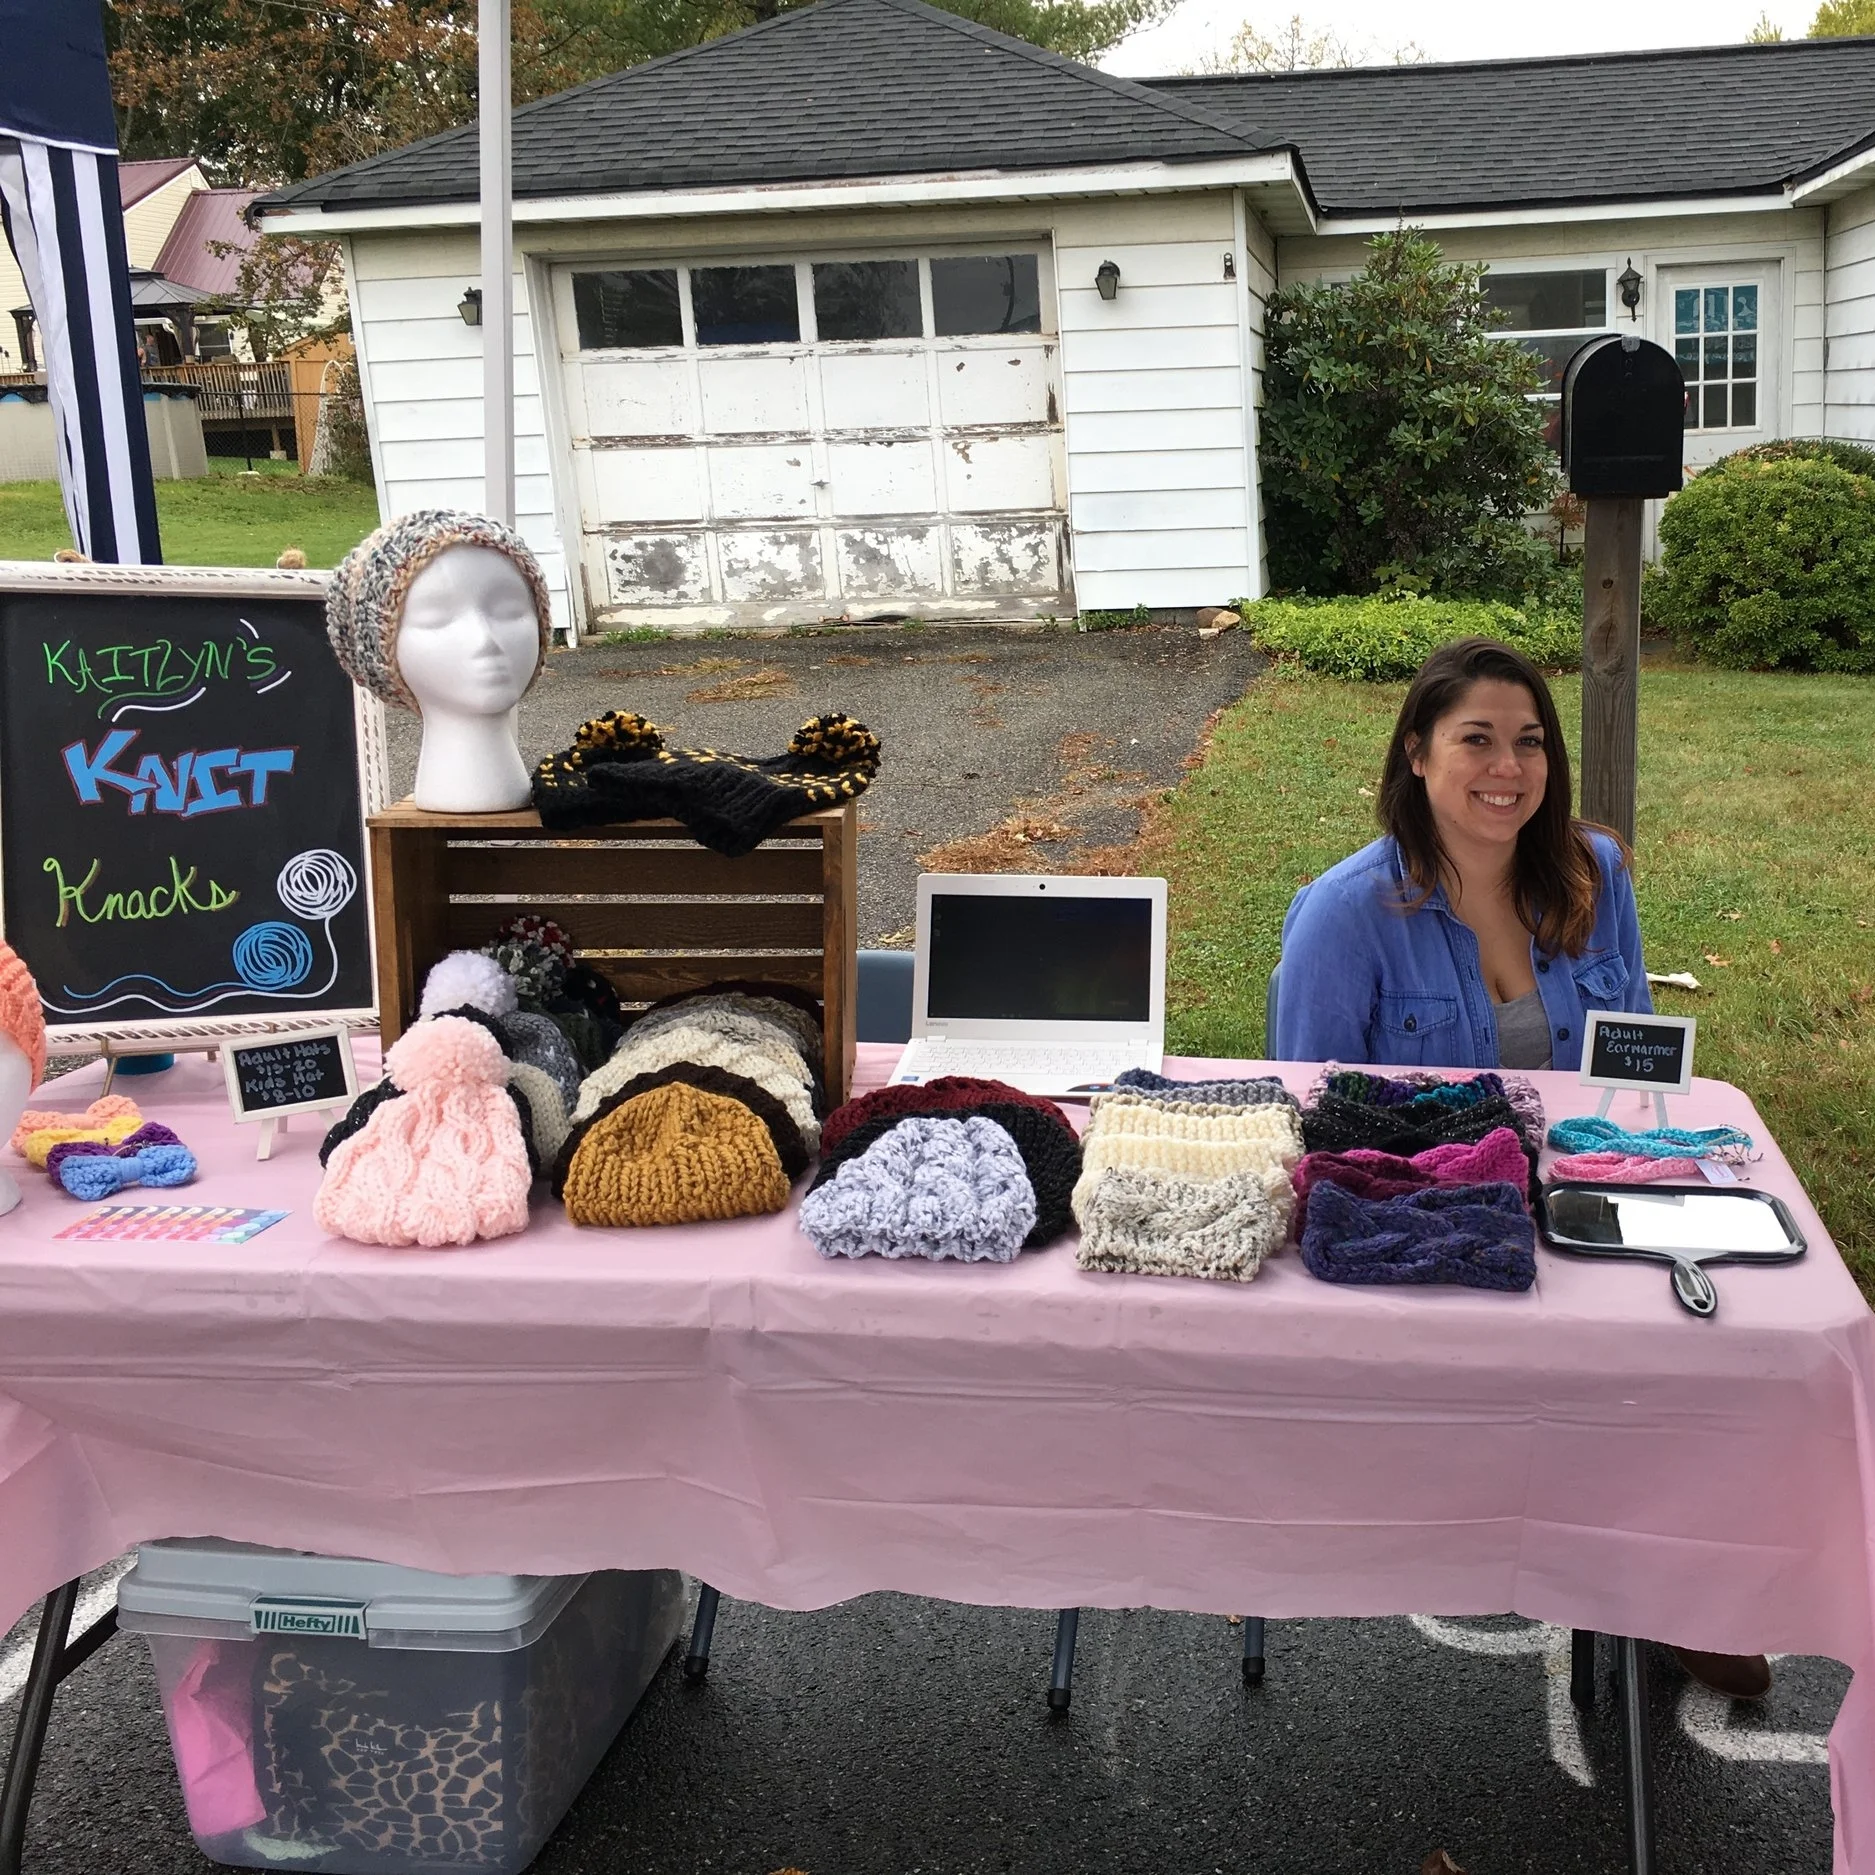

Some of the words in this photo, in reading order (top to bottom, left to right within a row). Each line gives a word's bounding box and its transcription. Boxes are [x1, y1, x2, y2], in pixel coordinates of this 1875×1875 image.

[61, 729, 298, 820] KNIT
[43, 856, 241, 927] Knacks
[1599, 1025, 1643, 1040] Adult
[238, 1047, 290, 1067] Adult
[293, 1042, 331, 1057] Hats
[1624, 1056, 1654, 1073] $15
[245, 1077, 286, 1093] Kids
[293, 1069, 325, 1085] Hat
[283, 1615, 331, 1631] Hefty
